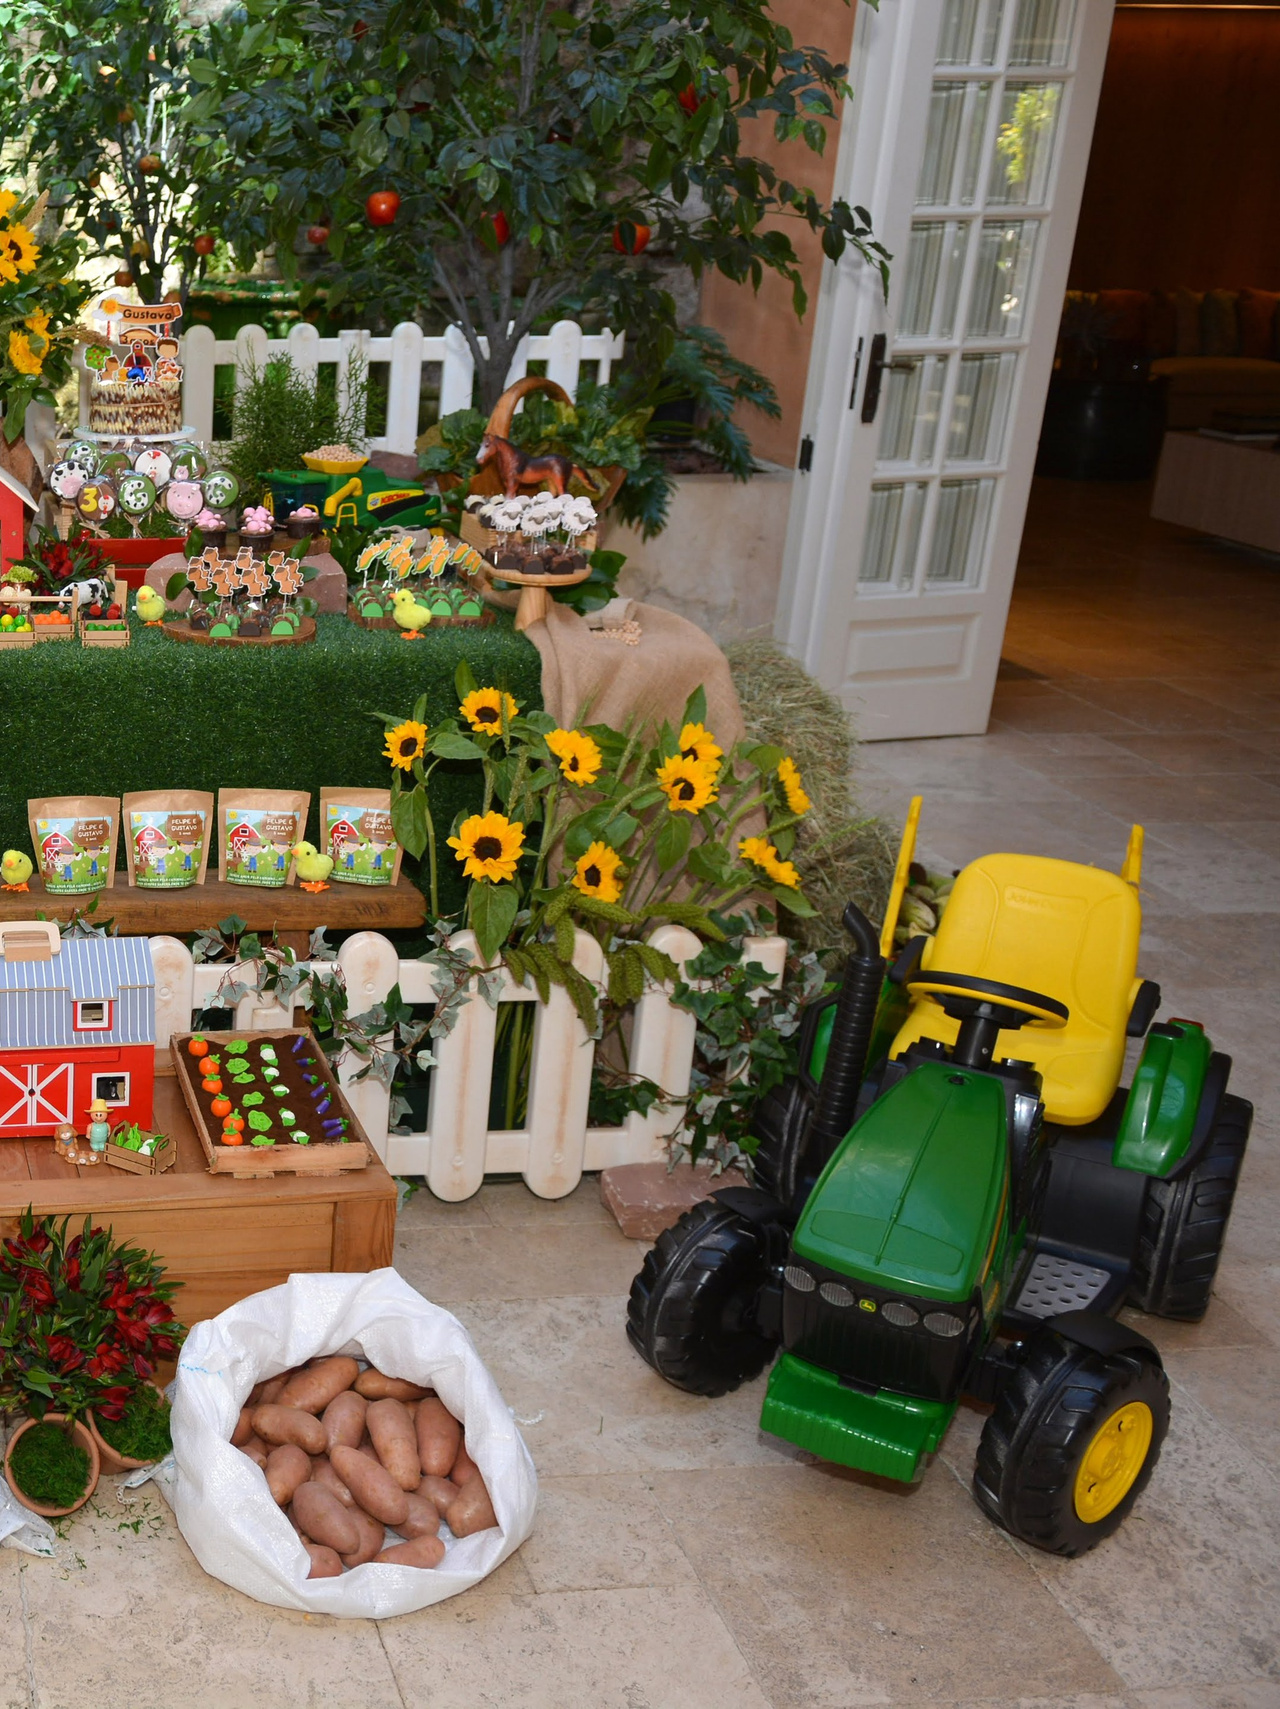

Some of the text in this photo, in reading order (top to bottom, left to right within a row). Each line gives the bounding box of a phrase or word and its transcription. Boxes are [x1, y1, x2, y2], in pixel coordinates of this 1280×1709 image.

[123, 308, 172, 320] Gustavo
[80, 487, 98, 512] 3
[124, 480, 149, 511] G
[77, 830, 103, 838] GUSTAVO
